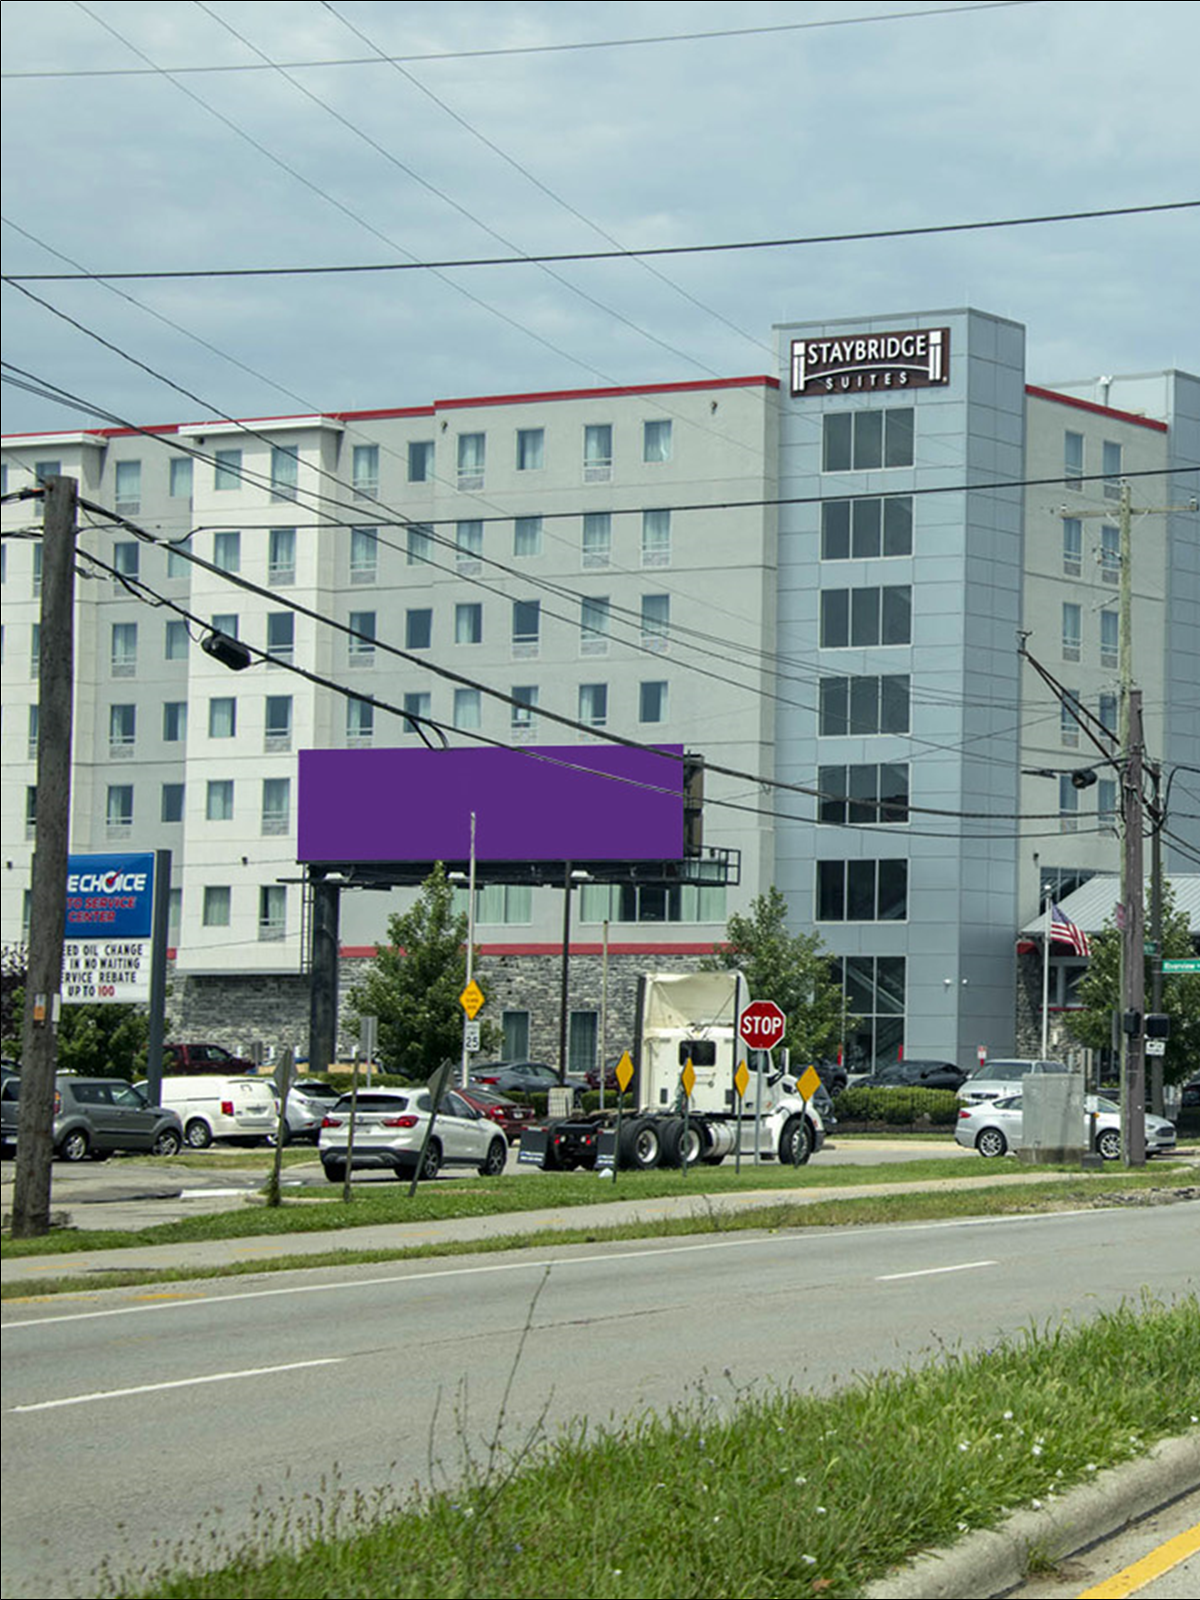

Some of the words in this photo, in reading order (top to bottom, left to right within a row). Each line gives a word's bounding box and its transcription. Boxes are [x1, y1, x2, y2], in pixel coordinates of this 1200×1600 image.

[808, 335, 927, 364] STAYBRIDGE
[826, 372, 907, 390] SUITES
[67, 870, 147, 893] ECHOICE
[67, 897, 83, 909] TO
[85, 896, 136, 909] SERVICE
[68, 910, 116, 922] CENTER
[83, 944, 98, 956] OIL
[105, 944, 143, 956] CHANGE
[70, 958, 79, 969] IN
[84, 958, 97, 969] NO
[100, 957, 140, 969] WAITING
[99, 971, 136, 983] REBATE
[68, 985, 81, 997] UP
[83, 985, 95, 997] TO
[98, 985, 115, 997] 100
[742, 1016, 782, 1035] STOP
[466, 1036, 478, 1048] 25
